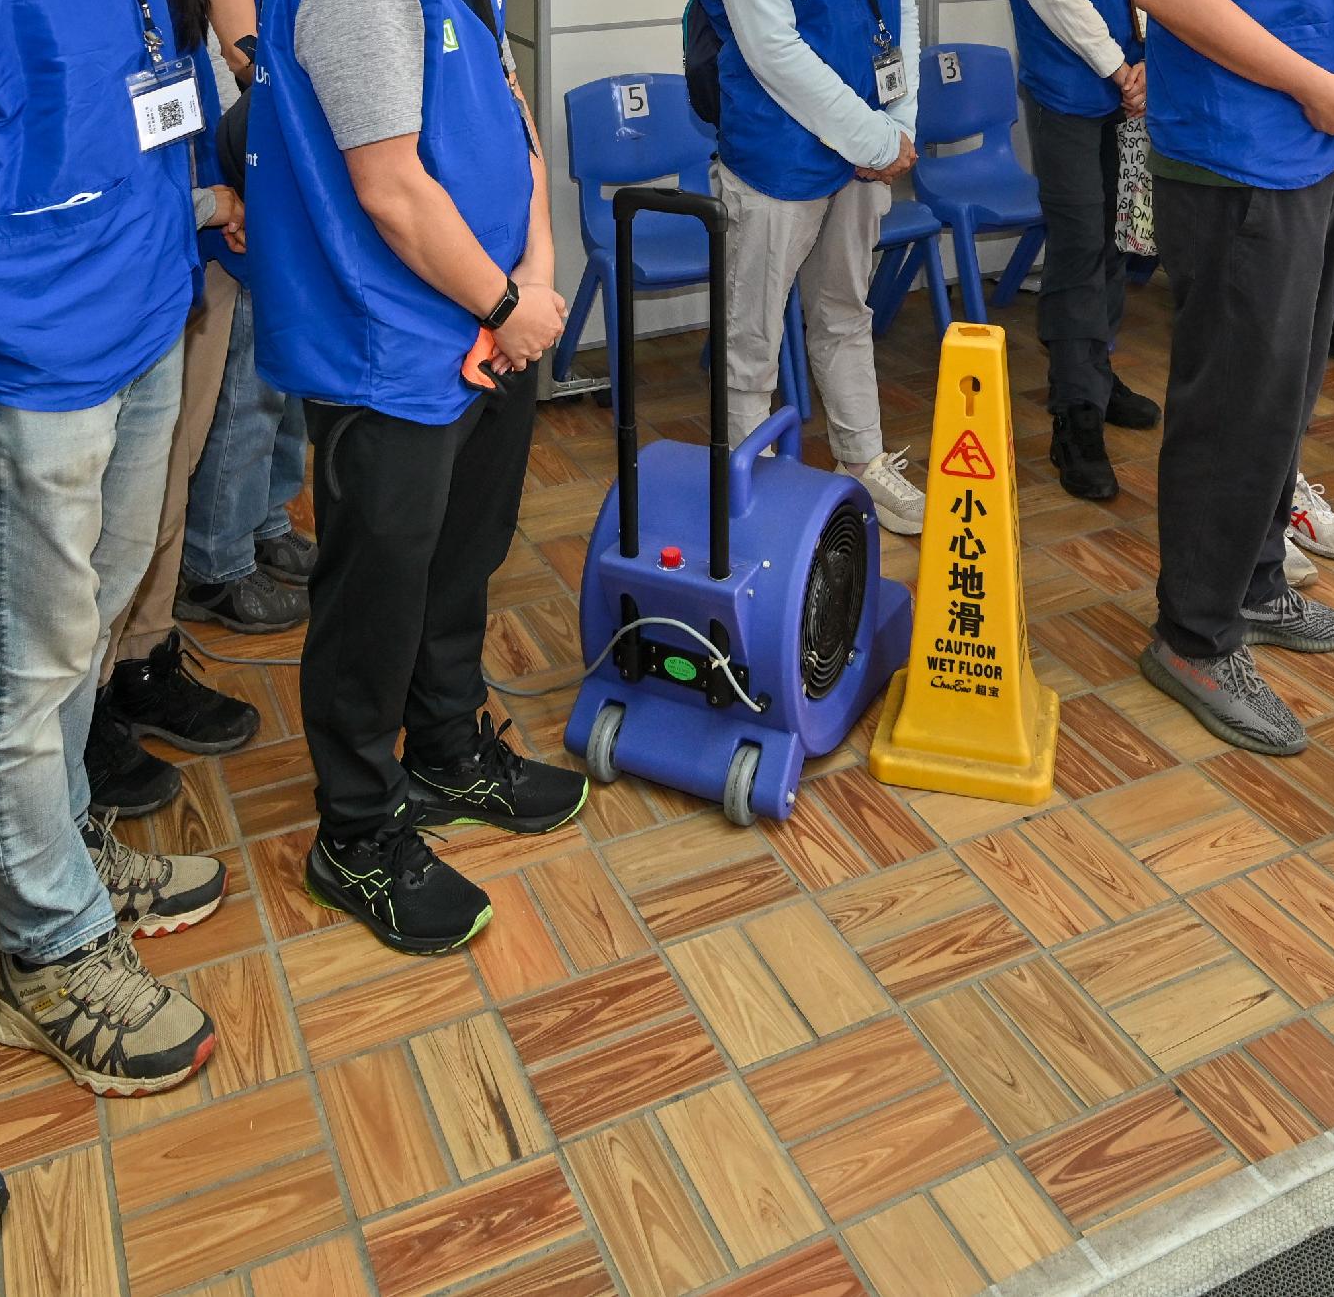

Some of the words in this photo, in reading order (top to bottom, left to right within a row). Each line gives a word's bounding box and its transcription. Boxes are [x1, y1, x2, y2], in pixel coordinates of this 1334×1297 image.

[943, 57, 956, 79] 3
[628, 86, 644, 112] 5
[947, 489, 987, 639] 小心地滑
[934, 638, 996, 660] CAUTION
[926, 656, 956, 674] WET
[958, 660, 1003, 681] FLOOR
